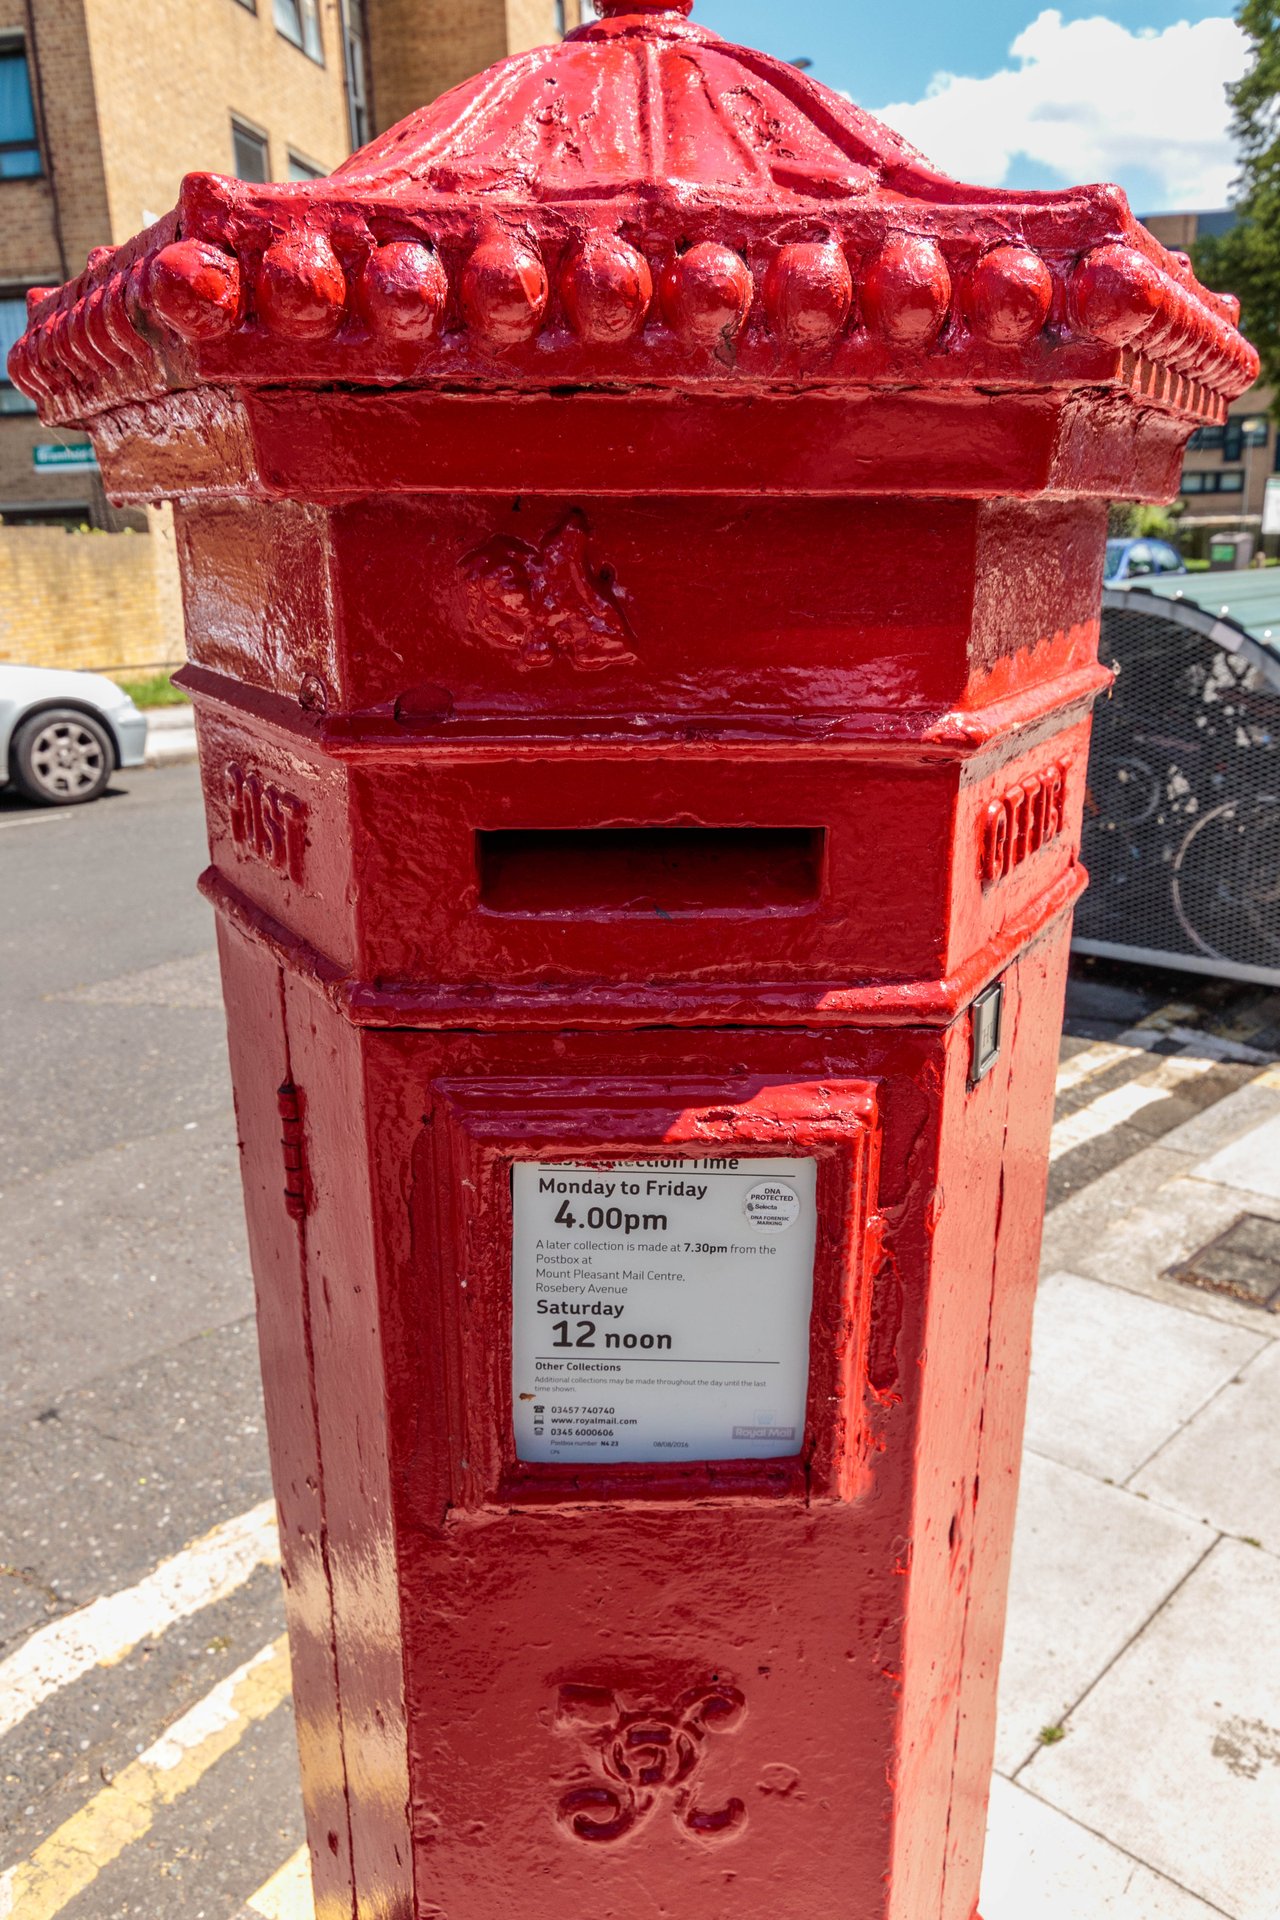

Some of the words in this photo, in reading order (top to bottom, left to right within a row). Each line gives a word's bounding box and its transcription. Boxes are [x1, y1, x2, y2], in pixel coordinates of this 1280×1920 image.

[538, 1177, 616, 1198] Monday
[620, 1180, 640, 1195] to
[646, 1180, 708, 1200] Friday
[750, 1194, 794, 1202] PROTECTED
[554, 1199, 668, 1235] 4.00pm
[535, 1239, 544, 1250] A
[546, 1239, 571, 1250] later
[573, 1240, 624, 1251] collection
[626, 1241, 635, 1252] is
[637, 1242, 668, 1253] made
[670, 1243, 681, 1253] at
[683, 1242, 728, 1255] 7.30pm
[730, 1243, 757, 1254] from
[759, 1244, 777, 1255] the
[536, 1253, 580, 1264] Postbox
[581, 1255, 593, 1265] at
[536, 1268, 571, 1279] Mount
[573, 1269, 620, 1280] Pleasant
[622, 1270, 645, 1280] Mail
[535, 1282, 586, 1295] Rosebery
[587, 1283, 628, 1294] Avenue
[536, 1299, 625, 1319] Saturday
[552, 1320, 596, 1348] 12
[604, 1332, 672, 1350] noon
[535, 1361, 564, 1371] Other
[566, 1362, 622, 1372] Collections
[656, 1378, 696, 1387] throughout
[710, 1379, 722, 1387] day
[724, 1379, 740, 1387] until
[551, 1385, 577, 1393] shown.
[551, 1406, 579, 1414] 03457
[581, 1406, 615, 1415] 740740
[551, 1417, 638, 1426] www.royalmail.com
[550, 1428, 573, 1436] 0345
[575, 1429, 614, 1437] 6000606
[735, 1427, 767, 1439] Royal
[767, 1428, 793, 1438] Mail
